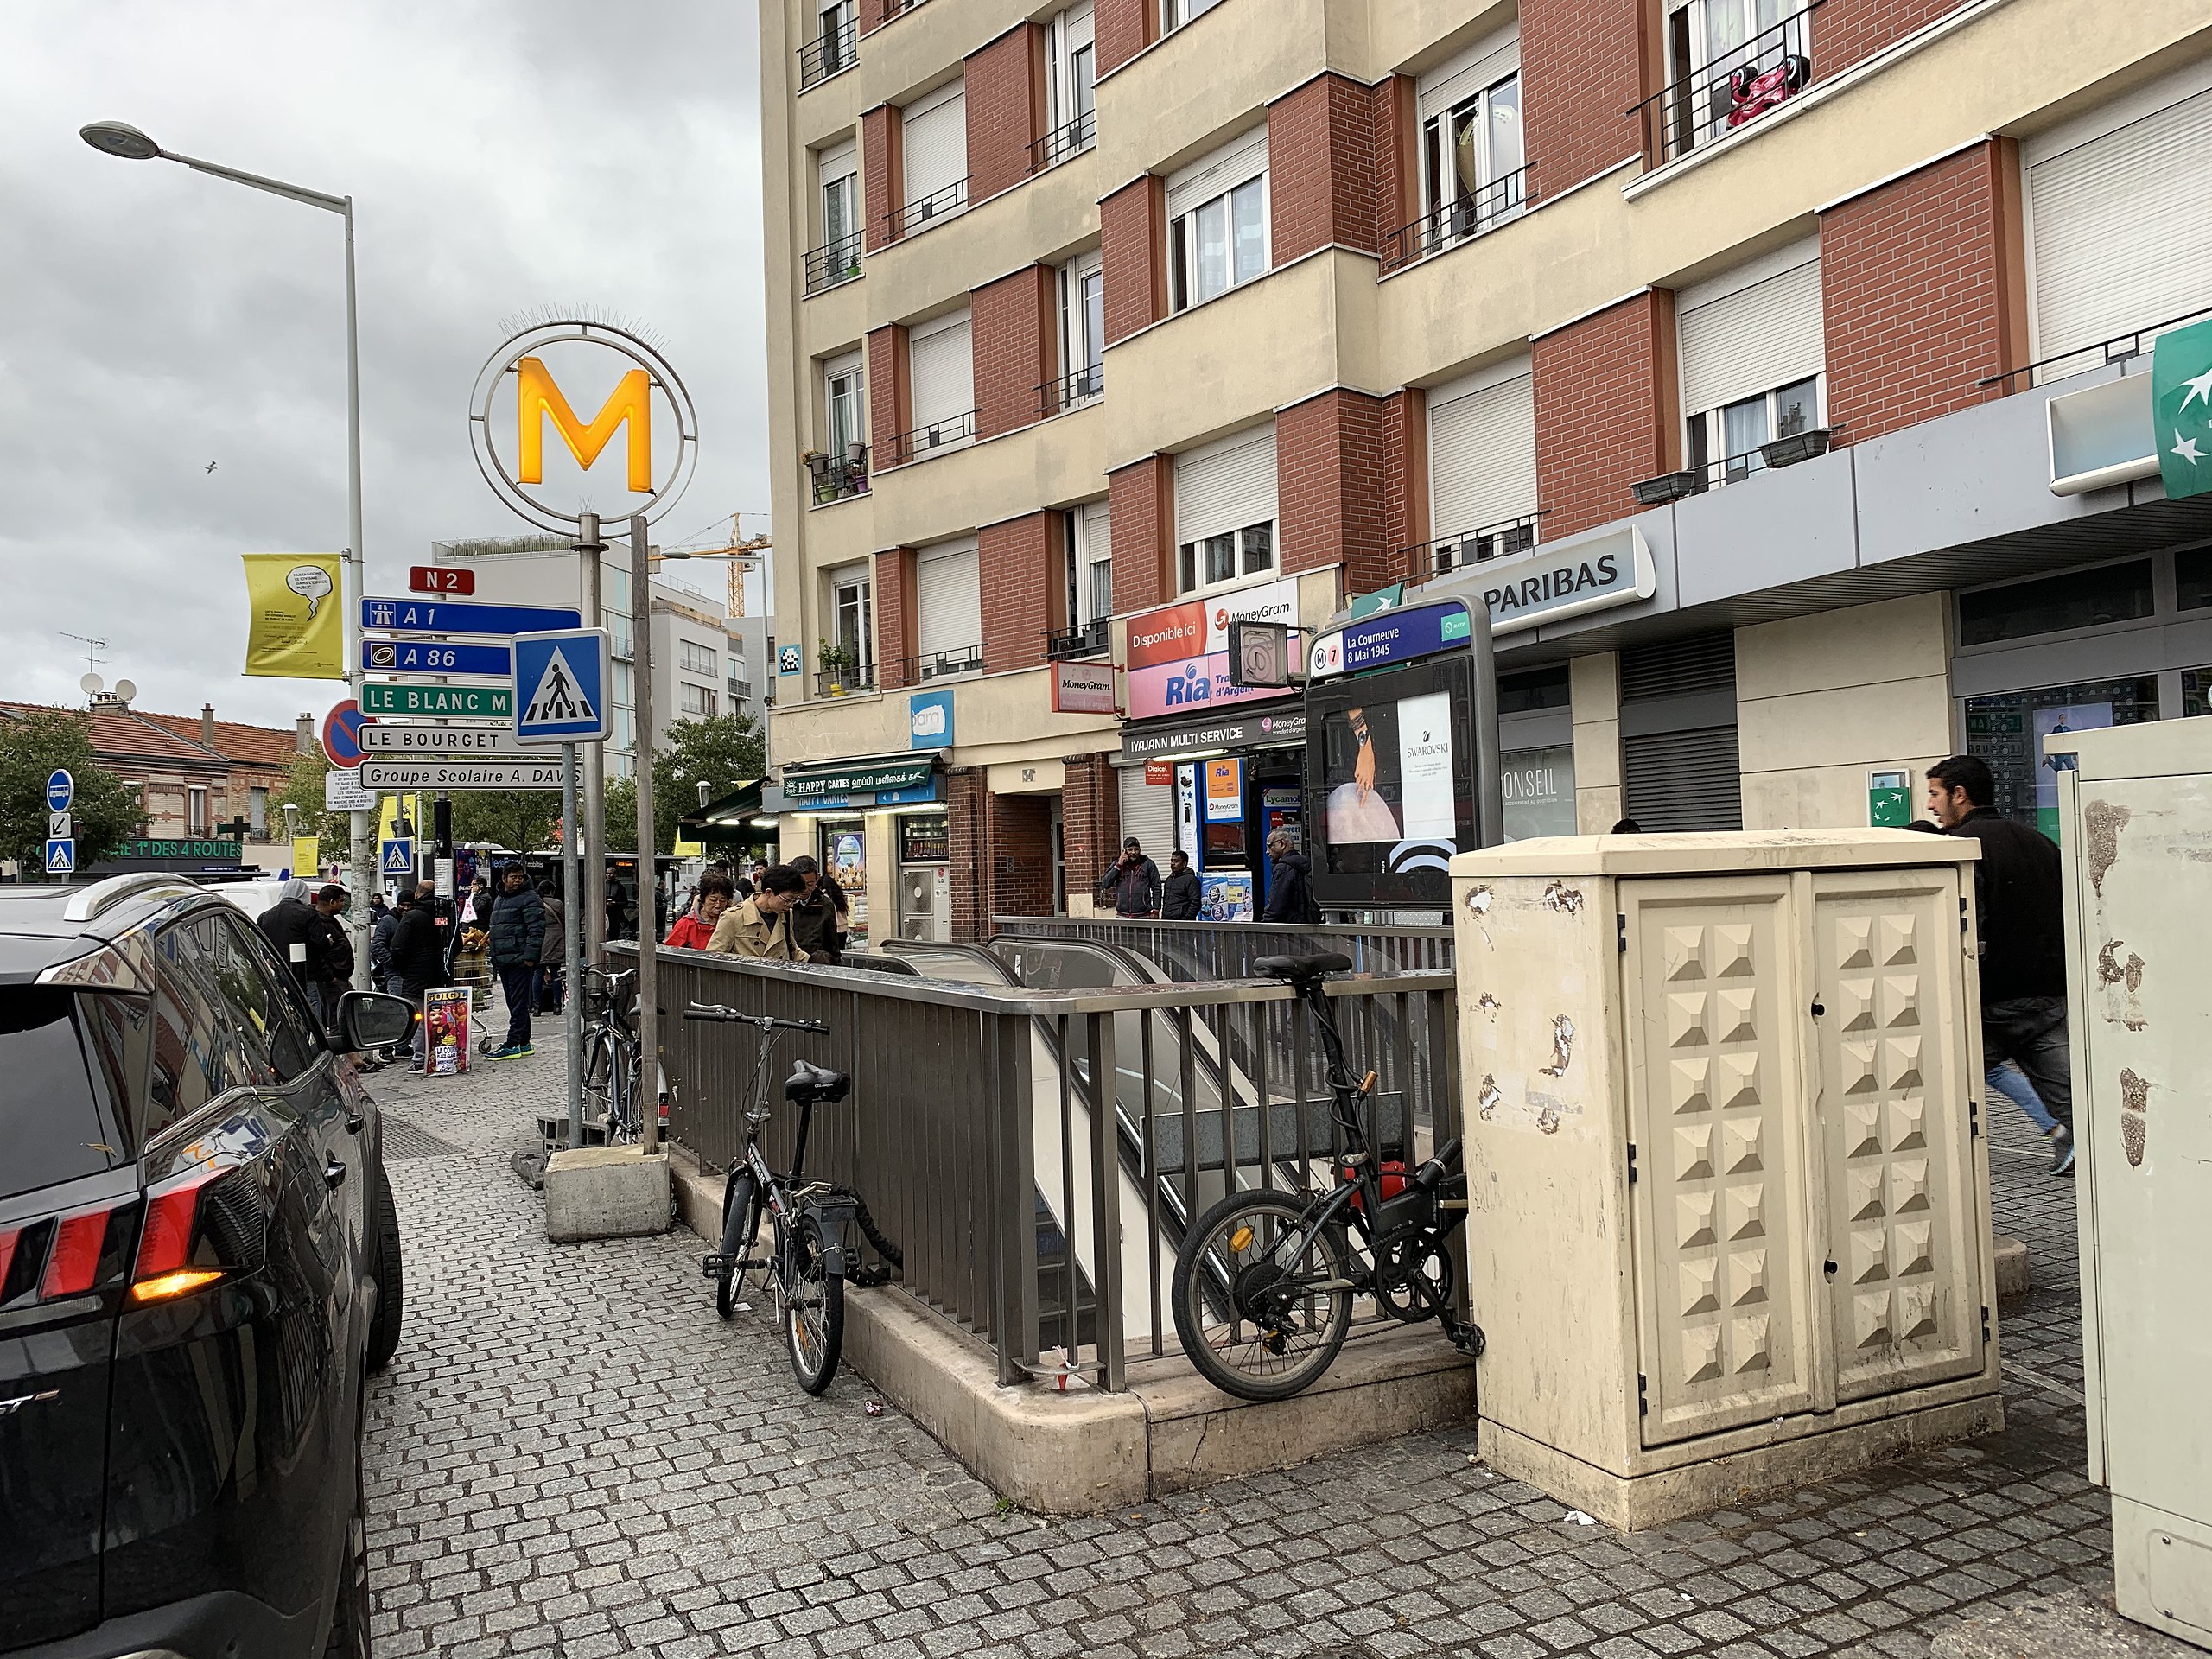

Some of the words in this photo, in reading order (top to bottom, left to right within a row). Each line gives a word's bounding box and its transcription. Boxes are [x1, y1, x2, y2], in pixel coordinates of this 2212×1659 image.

[518, 355, 652, 493] M
[426, 571, 438, 588] N
[446, 572, 458, 589] 2
[1484, 554, 1618, 613] PARIBAS
[404, 608, 417, 625] A
[427, 608, 435, 626] 1
[1232, 603, 1290, 623] MoneyGram
[1133, 626, 1183, 648] Disponible
[1184, 622, 1196, 636] ici
[1347, 637, 1356, 649] La
[1358, 628, 1400, 647] Courneuve
[404, 649, 417, 665] A
[427, 649, 456, 667] 86
[1331, 649, 1337, 662] 7
[1348, 653, 1353, 663] 8
[1355, 648, 1370, 662] Mai
[1371, 644, 1390, 659] 1945
[1062, 680, 1110, 691] MoneyGram
[1166, 663, 1210, 706] Ria
[370, 690, 394, 708] LE
[408, 693, 479, 710] BLANC
[1272, 717, 1306, 728] MoneyGra
[368, 732, 391, 746] LE
[403, 733, 499, 747] BOURGET
[1131, 736, 1167, 753] IYAJANN
[1170, 733, 1199, 748] MULTI
[1200, 727, 1243, 744] SERVICE
[1407, 743, 1449, 758] SWAROVSKI
[371, 769, 429, 785] Groupe
[437, 769, 504, 782] Scolaire
[511, 770, 525, 782] A.
[532, 770, 582, 783] DAVS
[798, 780, 826, 793] HAPPY
[828, 779, 850, 789] CARTES
[1501, 769, 1557, 799] ONSEIL
[1266, 795, 1302, 804] Lycamob
[152, 842, 177, 856] DES
[181, 842, 189, 857] 4
[193, 842, 243, 858] ROUTES
